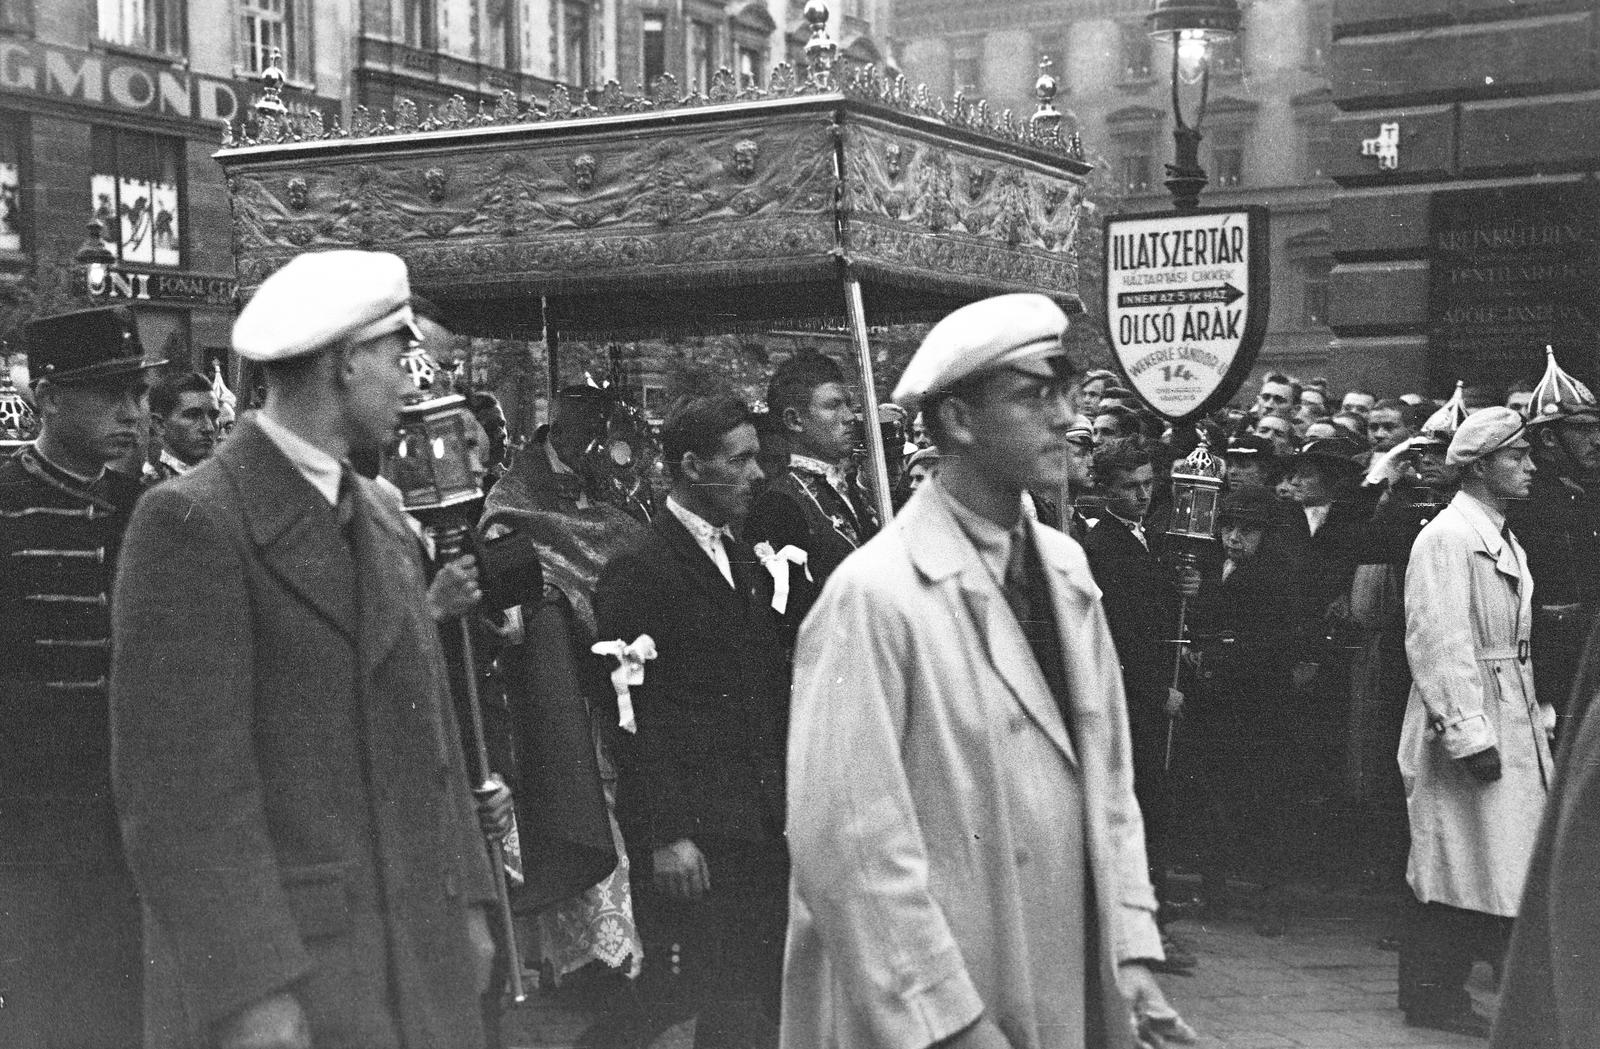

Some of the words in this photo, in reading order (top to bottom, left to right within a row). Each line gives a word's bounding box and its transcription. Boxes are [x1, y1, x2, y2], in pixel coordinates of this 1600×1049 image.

[1113, 216, 1244, 271] ILLATSZERTÁR
[1122, 294, 1157, 305] INNEN
[1160, 293, 1174, 303] AZ
[1119, 306, 1175, 345] OLCSÓ
[1129, 347, 1174, 378] WEKERLE
